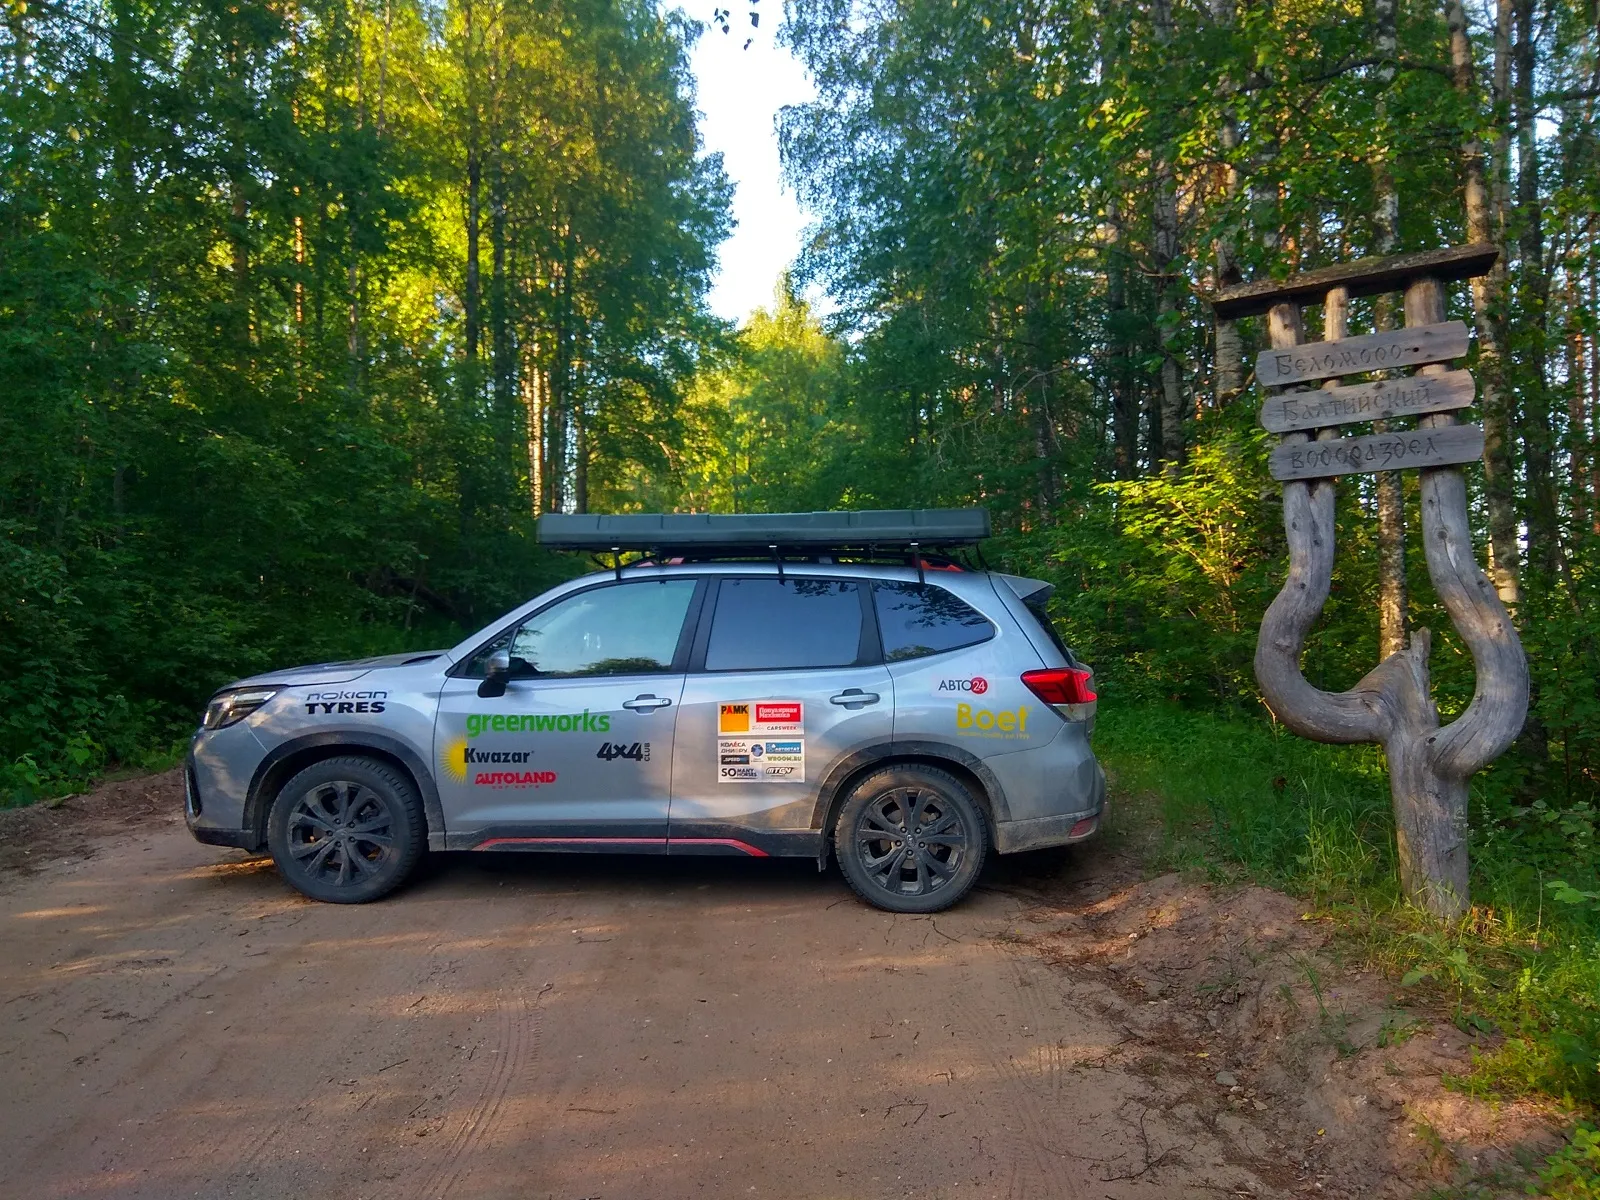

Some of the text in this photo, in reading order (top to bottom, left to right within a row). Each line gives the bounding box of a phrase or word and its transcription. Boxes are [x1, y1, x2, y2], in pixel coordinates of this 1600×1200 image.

[306, 690, 388, 701] nokian
[305, 701, 386, 715] TYRES
[466, 708, 611, 738] greenworks
[957, 703, 1028, 732] Boet
[464, 747, 531, 763] Kwazar
[596, 742, 644, 762] 4x4
[475, 771, 557, 785] AUTOLAND
[721, 768, 737, 777] SO
